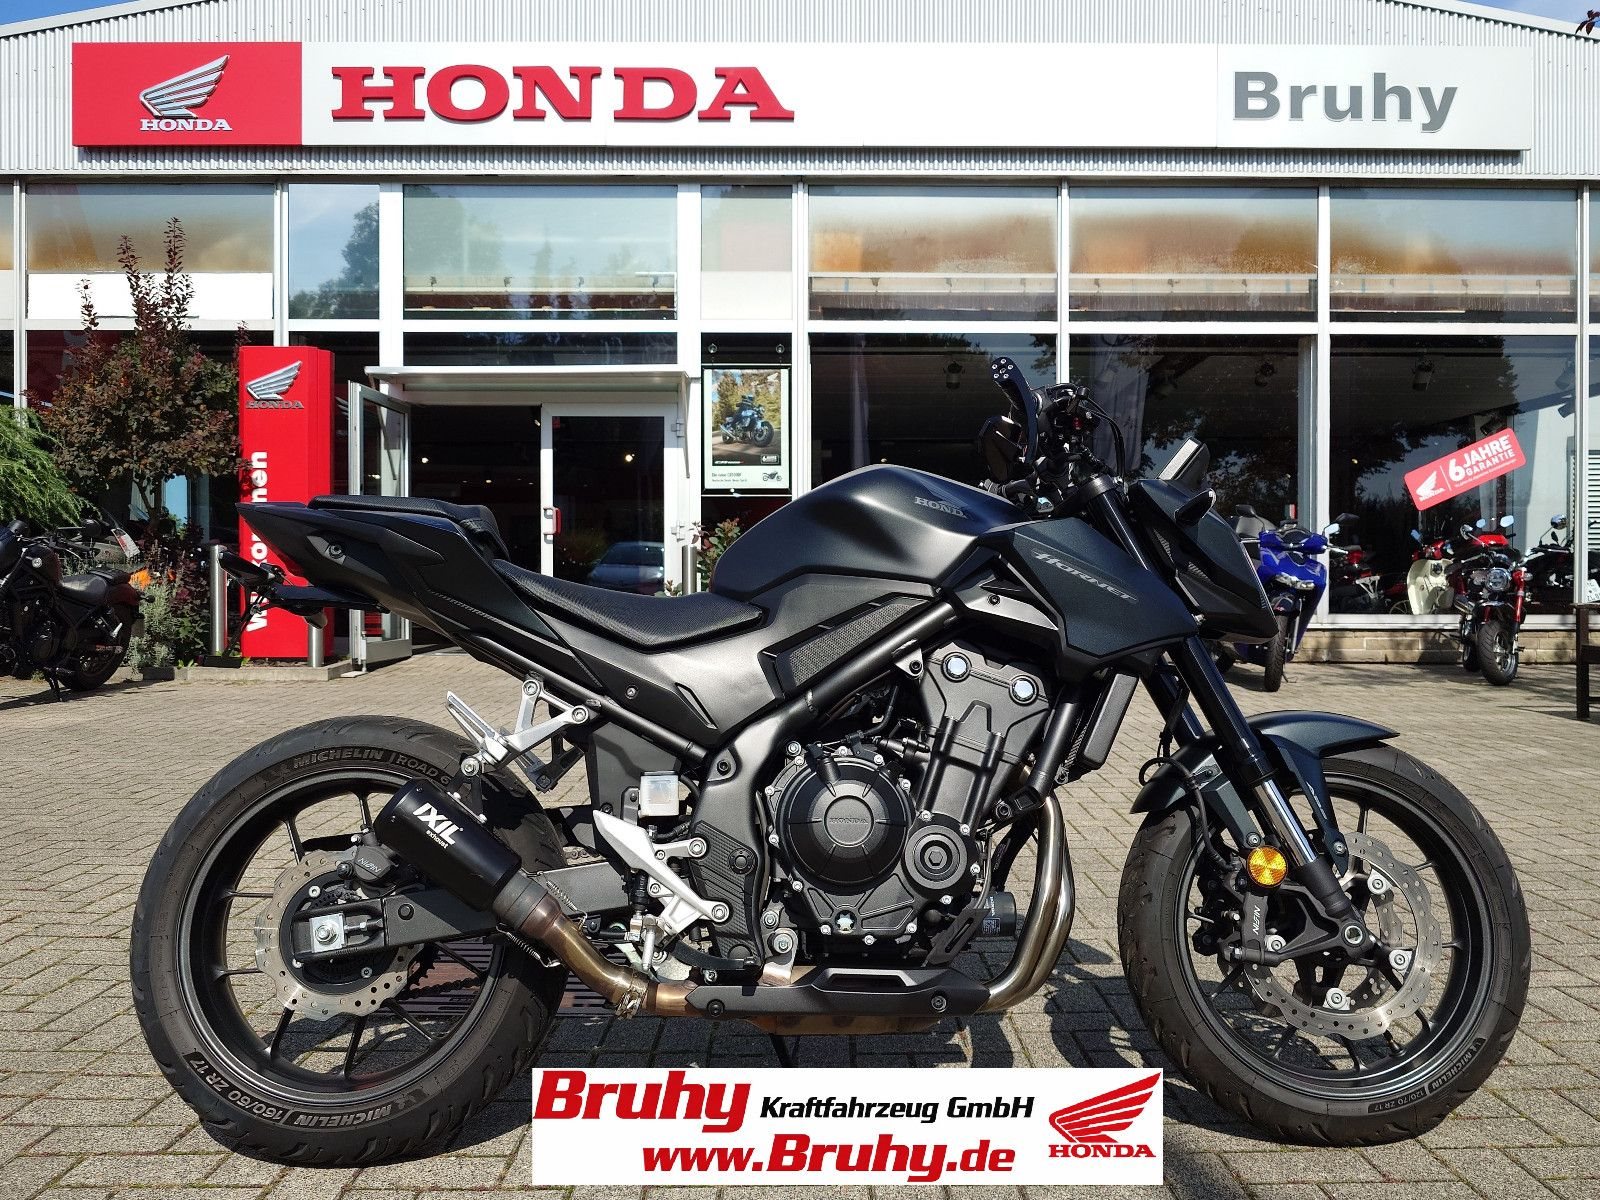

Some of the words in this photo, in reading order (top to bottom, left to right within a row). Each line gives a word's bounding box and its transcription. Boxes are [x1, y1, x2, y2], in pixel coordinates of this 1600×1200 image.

[331, 64, 795, 123] HONDA
[1232, 71, 1459, 134] Bruhy
[139, 118, 233, 132] HONDA
[246, 400, 305, 410] HONDA
[1448, 458, 1466, 482] 6
[1463, 434, 1512, 467] JAHRE
[1465, 448, 1516, 477] GARANTIE
[914, 496, 969, 520] HOND
[293, 749, 384, 769] MICHELIN
[397, 755, 440, 778] ROAD
[440, 775, 452, 786] 6
[426, 829, 449, 849] exhaust
[189, 1059, 209, 1075] 17
[1431, 1053, 1473, 1090] MICHELIN
[205, 1070, 230, 1092] ZR
[227, 1090, 283, 1121] 160/60
[293, 1104, 393, 1127] MICHELIN
